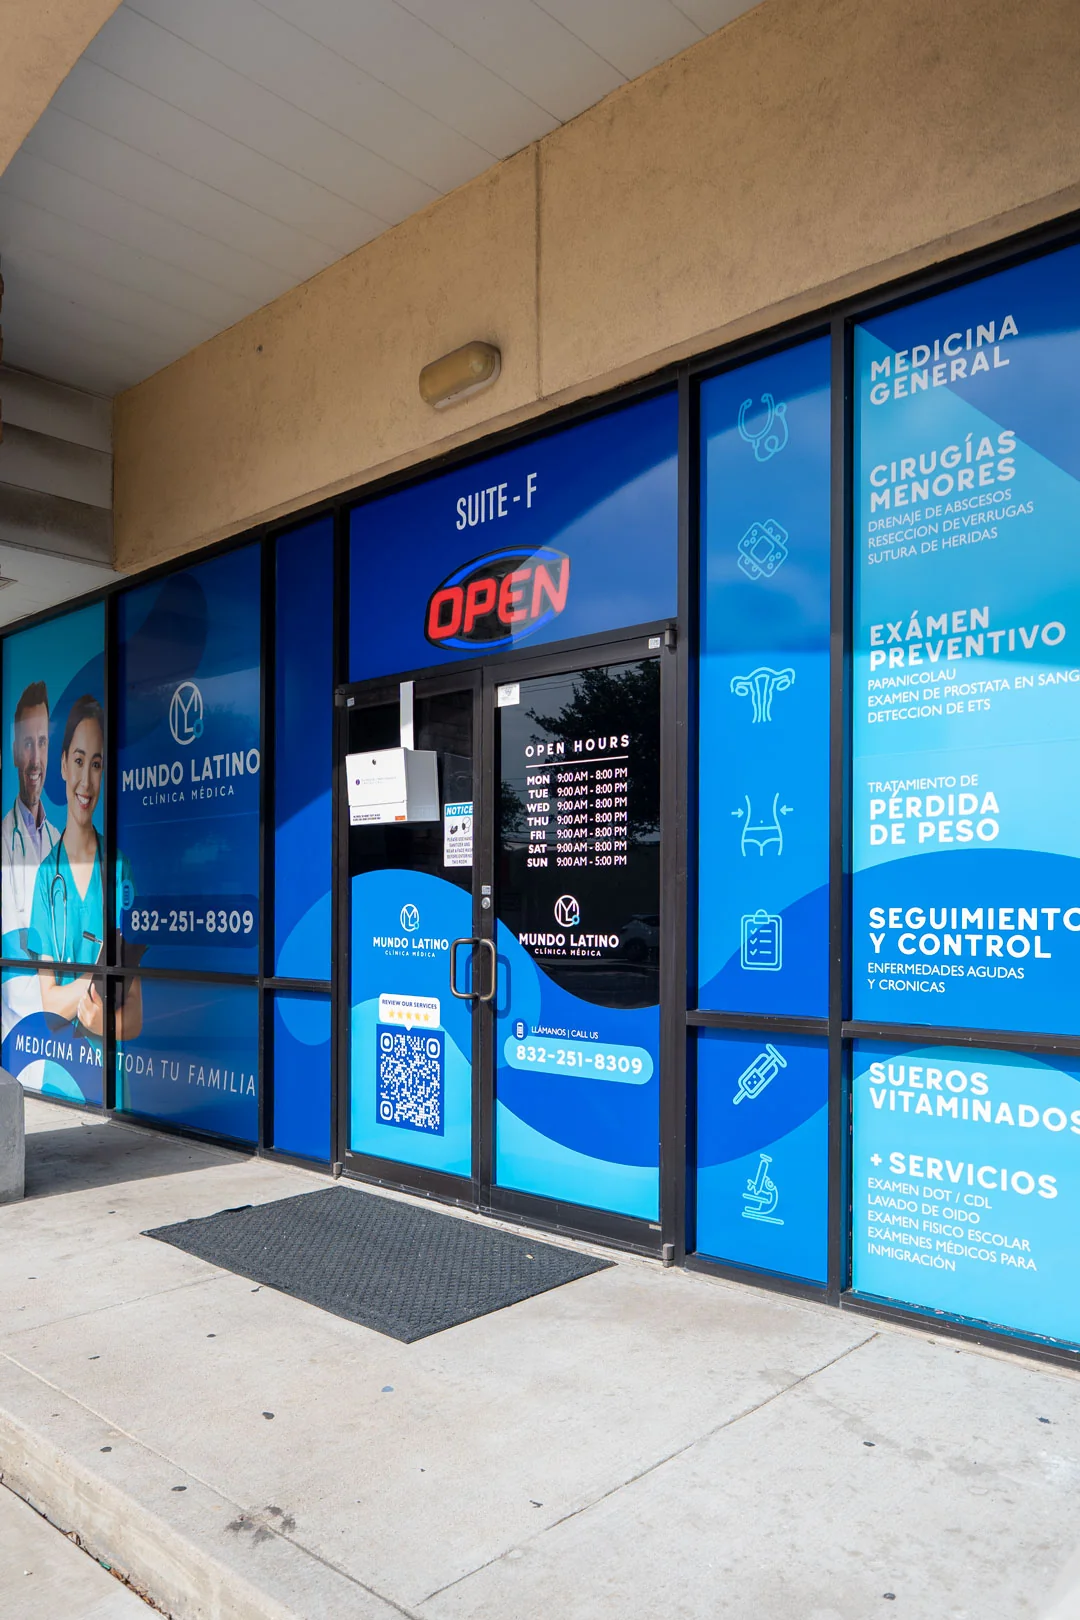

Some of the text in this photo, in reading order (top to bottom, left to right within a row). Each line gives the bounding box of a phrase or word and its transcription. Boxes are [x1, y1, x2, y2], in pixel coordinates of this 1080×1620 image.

[871, 314, 1019, 382] MEDICINA
[869, 346, 1010, 405] GENERAL
[869, 430, 1016, 487] CIRUGÍAS
[870, 457, 1016, 513] MENORES
[456, 482, 508, 530] SUITE
[527, 472, 537, 508] F
[868, 489, 1012, 533] DRENAJE DE ABSCESOS
[868, 501, 1034, 548] RESECCION DE VERRUGAS
[868, 527, 998, 564] SUTURA DE HERIDAS
[428, 558, 570, 639] OPEN
[870, 606, 990, 646] EXÁMEN
[870, 621, 1066, 672] PREVENTIVO
[868, 668, 956, 691] PAPANICOLAU
[868, 690, 919, 707] EXAMEN
[923, 687, 940, 700] DE
[944, 679, 1010, 698] PROSTATA
[1014, 675, 1034, 689] EN
[868, 699, 991, 724] DETECCION DE ETS
[525, 734, 629, 757] OPEN HOURS
[122, 748, 260, 792] MUNDO LATINO
[526, 775, 550, 786] MON
[557, 773, 573, 783] 9:00
[574, 771, 588, 782] AM
[595, 769, 612, 780] 8:00
[614, 768, 628, 778] PM
[868, 774, 978, 793] TRATAMIENTO DE
[142, 784, 235, 806] CLÍNICA MÉDICA
[529, 789, 549, 799] TUE
[557, 787, 573, 797] 9:00
[574, 785, 588, 796] AM
[595, 784, 612, 794] 8:00
[614, 782, 627, 793] PM
[870, 787, 1000, 820] PÉRDIDA
[446, 806, 473, 816] NOTICE
[527, 803, 550, 813] WED
[557, 801, 573, 811] 9:00
[574, 800, 588, 810] AM
[595, 798, 612, 808] 8:00
[614, 797, 627, 807] PM
[527, 816, 549, 826] THU
[557, 815, 573, 825] 9:00
[574, 814, 588, 824] AM
[595, 812, 612, 823] 8:00
[614, 811, 627, 822] PM
[530, 830, 546, 840] FRI
[557, 829, 573, 839] 9:00
[574, 828, 588, 838] AM
[595, 827, 612, 837] 8:00
[614, 826, 627, 836] PM
[870, 818, 999, 846] DE PESO
[528, 844, 548, 854] SAT
[556, 843, 572, 853] 9:00
[574, 842, 587, 852] AM
[595, 841, 612, 852] 8:00
[614, 840, 627, 851] PM
[527, 858, 548, 868] SUN
[556, 857, 572, 867] 9:00
[574, 856, 587, 867] AM
[595, 856, 612, 866] 5:00
[614, 855, 627, 865] PM
[131, 910, 253, 934] 832-251-8309
[373, 936, 449, 951] MUNDO LATINO
[412, 950, 436, 958] MÉDICA
[519, 932, 619, 948] MUNDO LATINO
[534, 946, 601, 957] CLÍNICA MÉDICA
[869, 932, 1052, 959] Y CONTROL
[868, 962, 1025, 979] ENFERMEDADES AGUDAS
[868, 979, 946, 993] Y CRONICAS
[414, 1002, 437, 1010] SERVICES
[531, 1025, 566, 1037] LLÁMANOS
[571, 1029, 588, 1038] CALL
[589, 1031, 599, 1039] US
[16, 1034, 256, 1096] MEDICINA PAR TODA TU FAMILIA
[516, 1045, 642, 1075] 832-251-8309
[869, 1062, 989, 1096] SUEROS
[889, 1151, 1058, 1199] SERVICIOS
[867, 1177, 919, 1196] EXAMEN
[923, 1186, 952, 1202] DOT
[963, 1193, 992, 1209] CDL
[867, 1193, 980, 1224] LAVADO DE OIDO
[867, 1210, 1031, 1252] EXAMEN FISICO ESCOLAR
[867, 1226, 1037, 1272] EXÁMENES MÉDICOS PARA
[867, 1243, 956, 1272] INMIGRACIÓN
